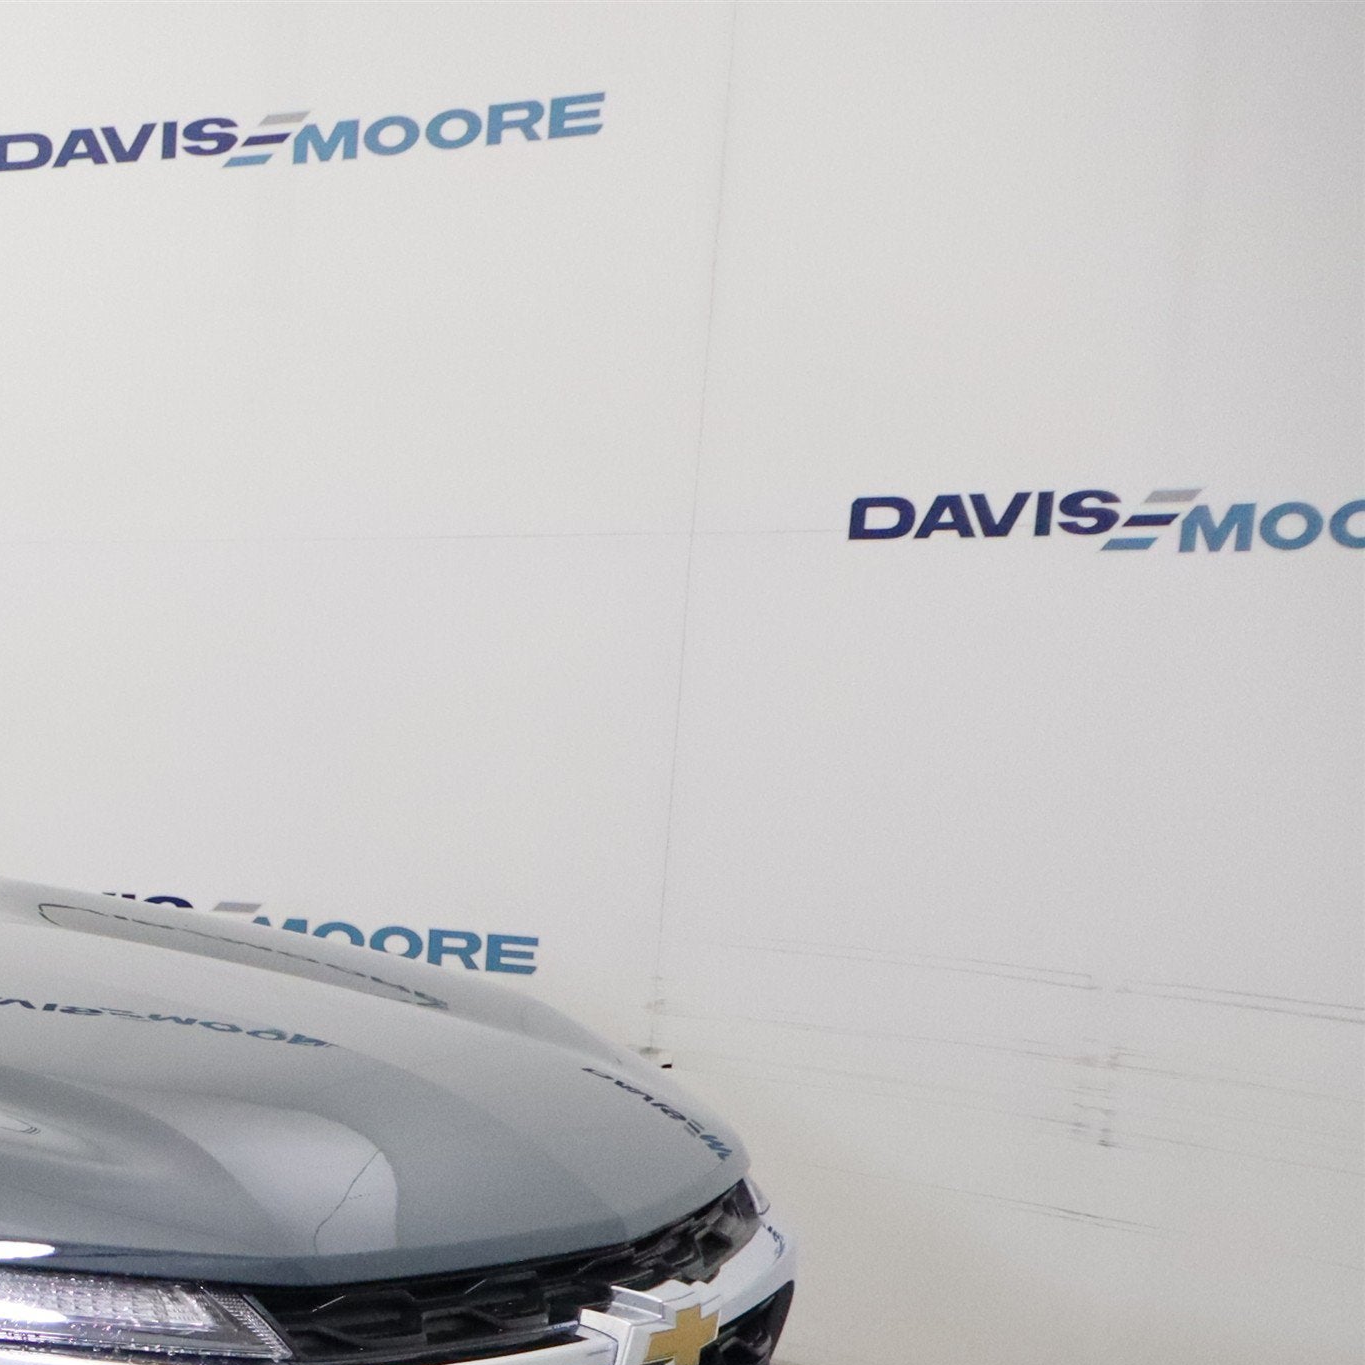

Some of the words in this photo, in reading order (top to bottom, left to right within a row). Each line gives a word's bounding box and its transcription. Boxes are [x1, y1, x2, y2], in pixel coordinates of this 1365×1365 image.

[291, 91, 607, 166] MOORE
[847, 489, 1122, 541] DAVIS
[252, 916, 539, 975] ORE
